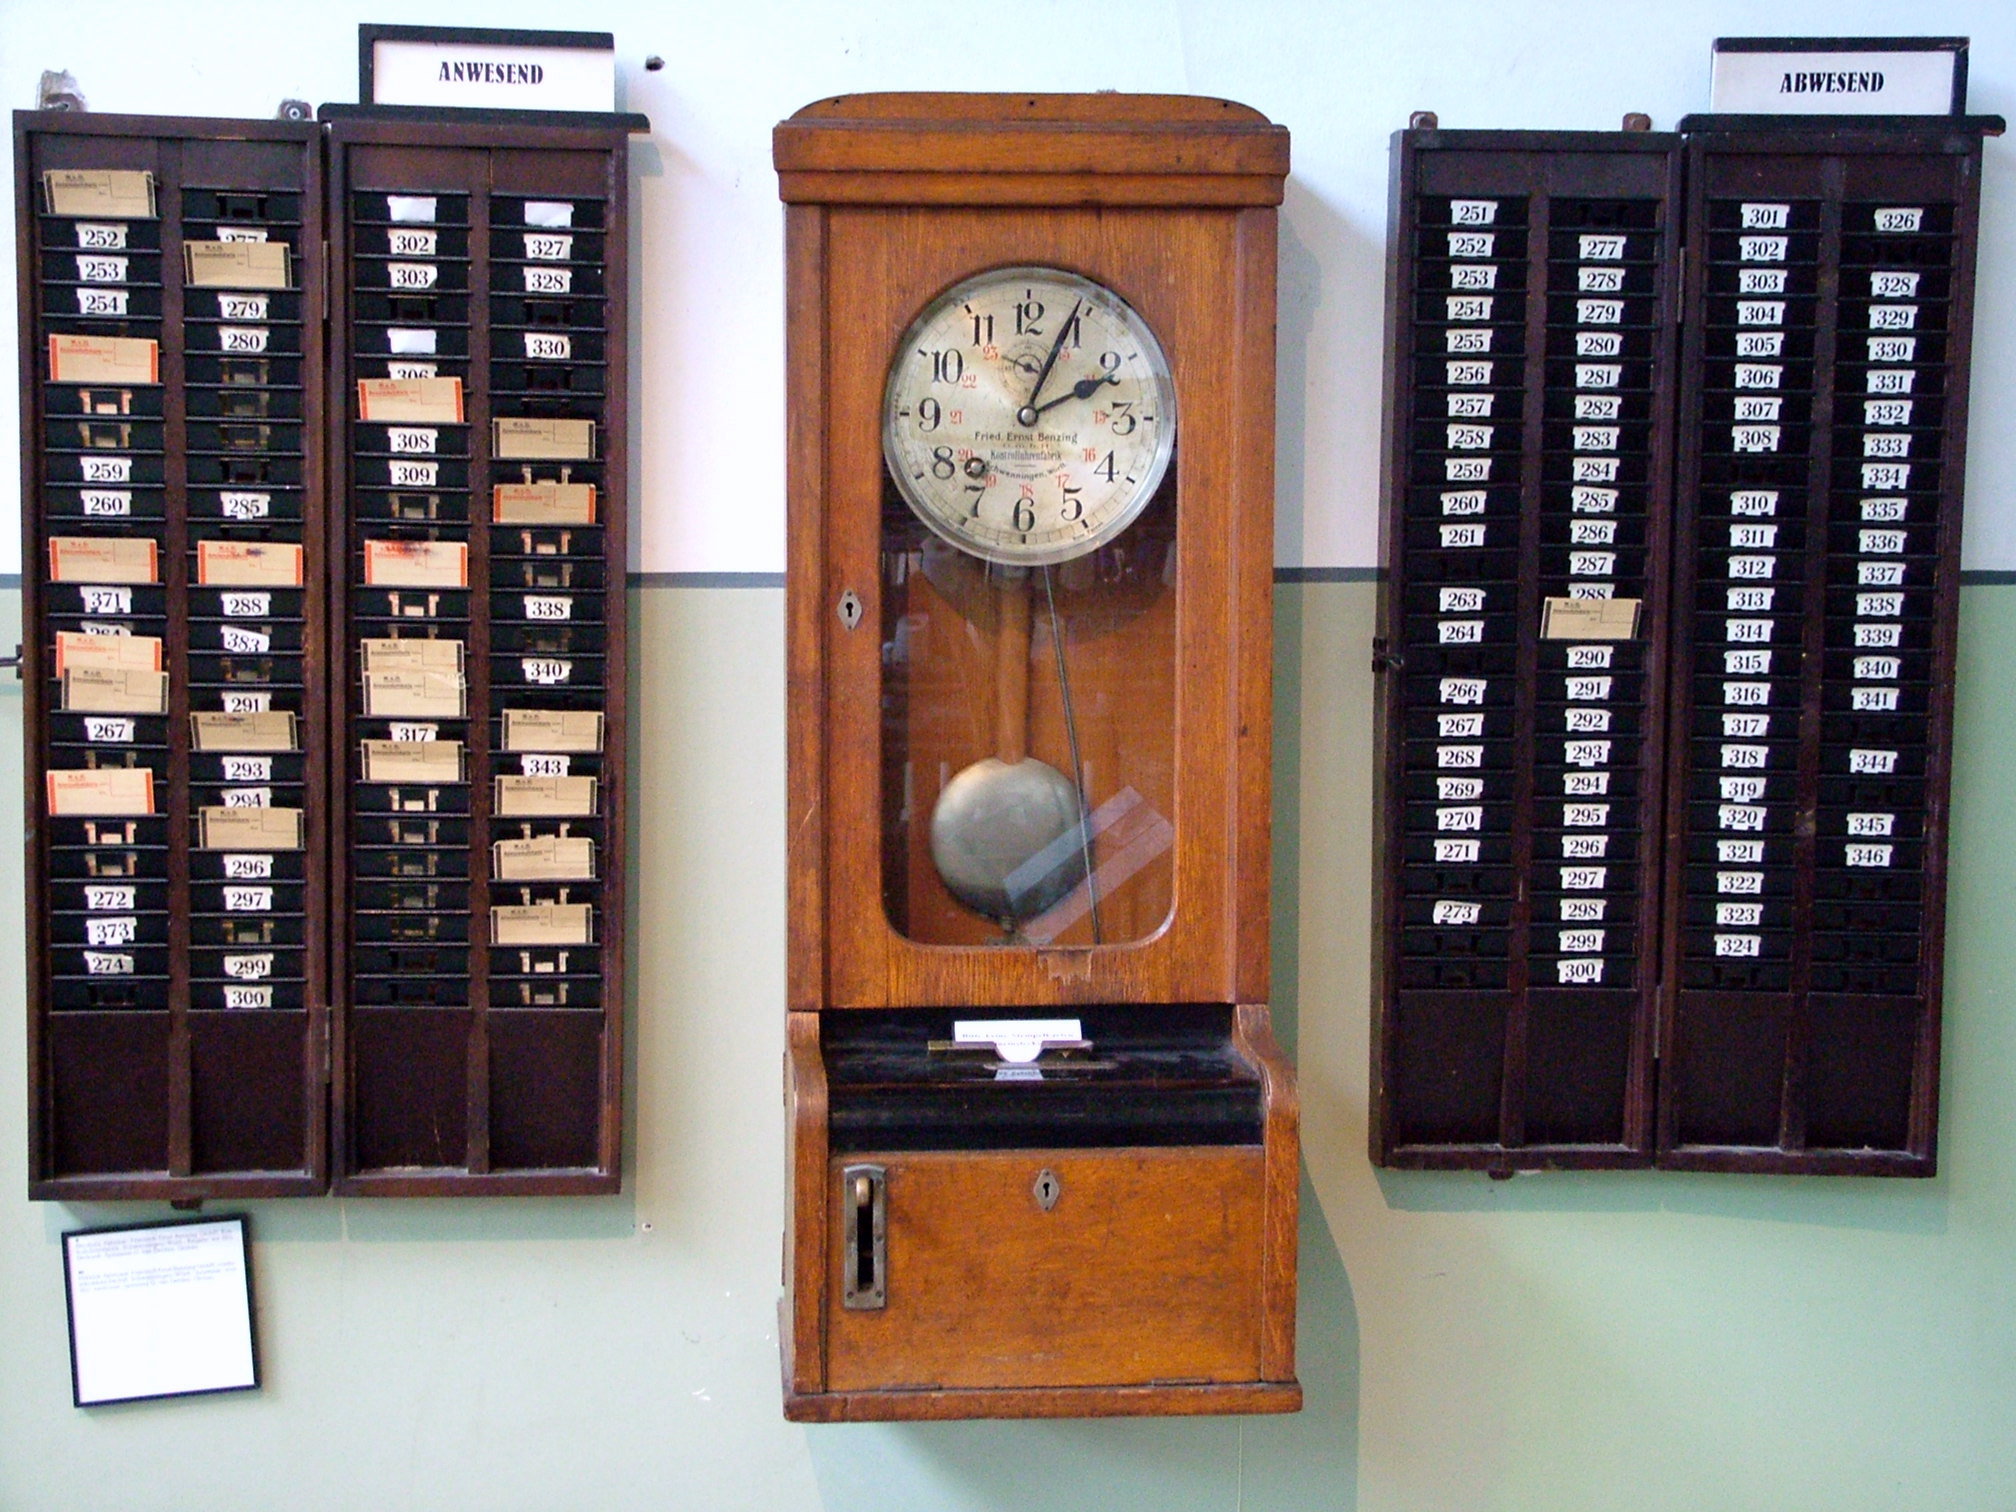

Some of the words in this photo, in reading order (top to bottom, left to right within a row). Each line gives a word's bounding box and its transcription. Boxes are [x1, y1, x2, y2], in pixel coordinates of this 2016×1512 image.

[439, 61, 543, 84] ANWESEND
[1780, 72, 1884, 93] ABWESEND
[1459, 205, 1487, 222] 251
[1749, 208, 1778, 225] 301
[1882, 213, 1915, 230] 326
[85, 229, 119, 248] 252
[396, 235, 429, 252] 302
[1455, 237, 1487, 254] 252
[532, 240, 564, 256] 327
[1586, 240, 1618, 257] 277
[1746, 241, 1780, 257] 302
[85, 262, 119, 279] 253
[396, 269, 429, 286] 303
[1457, 269, 1489, 286] 253
[531, 273, 564, 290] 328
[1586, 272, 1617, 289] 278
[1746, 274, 1779, 290] 303
[1878, 276, 1911, 293] 328
[86, 295, 118, 312] 254
[227, 301, 260, 317] 279
[1454, 300, 1484, 317] 254
[1014, 301, 1044, 336] 12
[1584, 304, 1616, 321] 279
[1744, 306, 1776, 322] 304
[1876, 310, 1910, 326] 329
[970, 313, 994, 346] 11
[1072, 315, 1082, 348] 1
[228, 333, 260, 350] 280
[532, 339, 565, 356] 330
[1453, 333, 1484, 350] 255
[1584, 337, 1615, 353] 280
[1743, 336, 1776, 353] 305
[1875, 342, 1908, 358] 330
[930, 349, 963, 385] 10
[1100, 351, 1121, 385] 2
[1454, 366, 1485, 382] 256
[1584, 369, 1611, 385] 281
[1742, 369, 1774, 385] 306
[1875, 374, 1904, 391] 331
[1454, 398, 1486, 414] 257
[1582, 399, 1614, 417] 282
[1741, 402, 1774, 418] 307
[1871, 404, 1905, 421] 332
[918, 397, 941, 432] 9
[1111, 402, 1136, 435] 3
[397, 434, 430, 449] 308
[1007, 432, 1033, 441] Ernst
[1038, 433, 1078, 444] Benzing
[1454, 428, 1485, 446] 258
[1580, 431, 1611, 447] 283
[1740, 430, 1772, 446] 308
[1870, 437, 1903, 454] 333
[932, 446, 955, 480] 8
[1082, 448, 1096, 462] 16
[90, 463, 123, 479] 259
[398, 467, 430, 482] 309
[1093, 450, 1120, 483] 4
[1453, 463, 1484, 479] 259
[1580, 461, 1610, 478] 284
[1868, 467, 1900, 484] 334
[90, 496, 123, 512] 260
[229, 499, 260, 515] 285
[964, 485, 986, 518] 7
[1061, 488, 1083, 521] 5
[1448, 495, 1479, 512] 260
[1578, 491, 1609, 509] 285
[1739, 495, 1769, 511] 310
[1013, 497, 1035, 532] 6
[1866, 502, 1899, 518] 335
[1448, 529, 1476, 545] 261
[1577, 524, 1608, 540] 286
[1739, 530, 1765, 545] 311
[1866, 534, 1898, 550] 336
[1577, 556, 1608, 572] 287
[1736, 559, 1766, 575] 312
[1864, 566, 1897, 582] 337
[92, 592, 120, 608] 371
[230, 599, 262, 614] 288
[1447, 592, 1478, 608] 263
[1735, 591, 1764, 607] 313
[1863, 597, 1895, 613] 338
[532, 601, 564, 616] 338
[1446, 624, 1475, 641] 264
[1734, 623, 1763, 639] 314
[1861, 628, 1893, 644] 339
[1574, 650, 1605, 666] 290
[1733, 654, 1762, 670] 315
[531, 662, 563, 677] 340
[1860, 660, 1892, 676] 340
[1447, 682, 1478, 698] 266
[1574, 681, 1603, 696] 291
[1731, 687, 1761, 702] 316
[231, 697, 261, 713] 291
[1860, 691, 1888, 707] 341
[1445, 717, 1476, 734] 267
[1572, 712, 1604, 728] 292
[1731, 718, 1760, 734] 317
[93, 723, 125, 739] 267
[399, 727, 429, 742] 317
[1445, 750, 1475, 765] 268
[1572, 744, 1603, 760] 293
[1729, 749, 1759, 765] 318
[231, 762, 263, 777] 293
[529, 759, 562, 775] 343
[1856, 753, 1888, 770] 344
[1444, 782, 1475, 797] 269
[1571, 776, 1600, 792] 294
[1728, 782, 1757, 797] 319
[230, 792, 262, 809] 294
[1444, 811, 1475, 827] 270
[1571, 808, 1601, 823] 295
[1726, 809, 1758, 824] 320
[1854, 816, 1885, 832] 345
[1443, 844, 1471, 859] 271
[1569, 839, 1600, 855] 296
[1726, 844, 1754, 859] 321
[1852, 848, 1884, 864] 346
[232, 860, 265, 876] 296
[1568, 871, 1598, 886] 297
[1724, 876, 1756, 891] 322
[94, 891, 127, 906] 272
[232, 892, 264, 907] 297
[1442, 904, 1473, 919] 273
[1568, 903, 1598, 918] 298
[1724, 907, 1755, 922] 323
[96, 923, 130, 939] 373
[1566, 934, 1597, 949] 299
[1722, 938, 1753, 953] 324
[92, 956, 125, 972] 274
[233, 959, 266, 976] 299
[1565, 962, 1596, 978] 300
[232, 990, 265, 1005] 300
